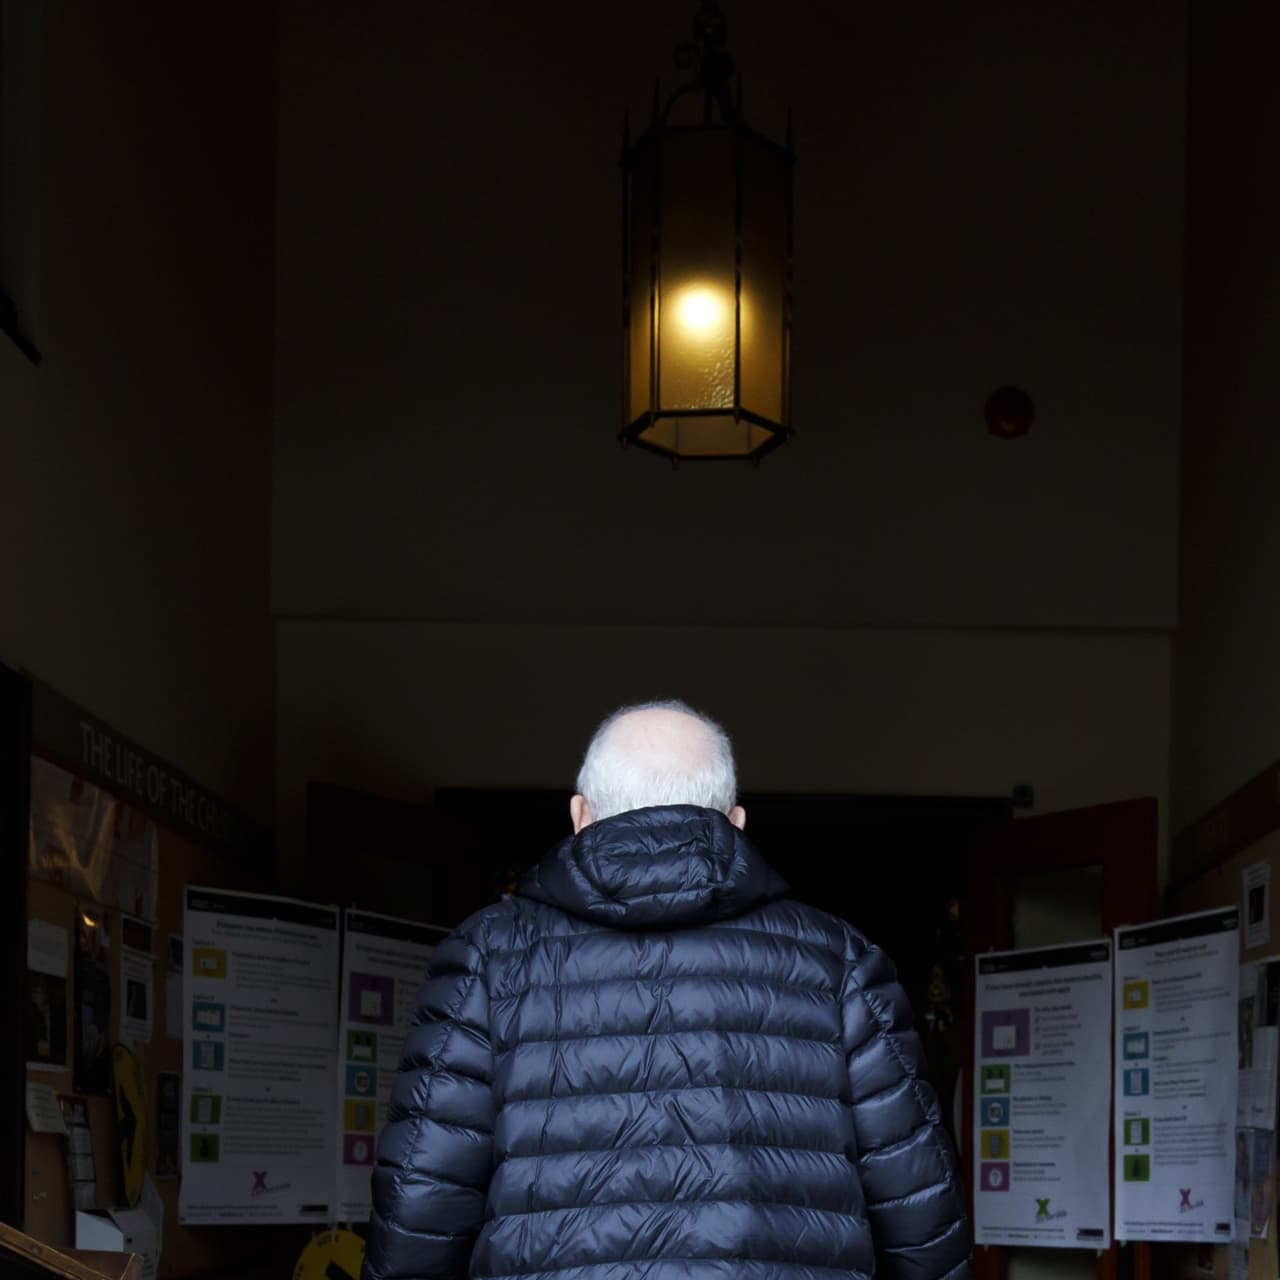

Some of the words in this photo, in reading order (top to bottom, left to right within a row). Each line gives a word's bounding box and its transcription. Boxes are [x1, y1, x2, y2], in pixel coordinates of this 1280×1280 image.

[80, 719, 112, 778] THE
[116, 742, 145, 798] LIFE
[146, 764, 169, 809] OF
[169, 777, 196, 826] THE
